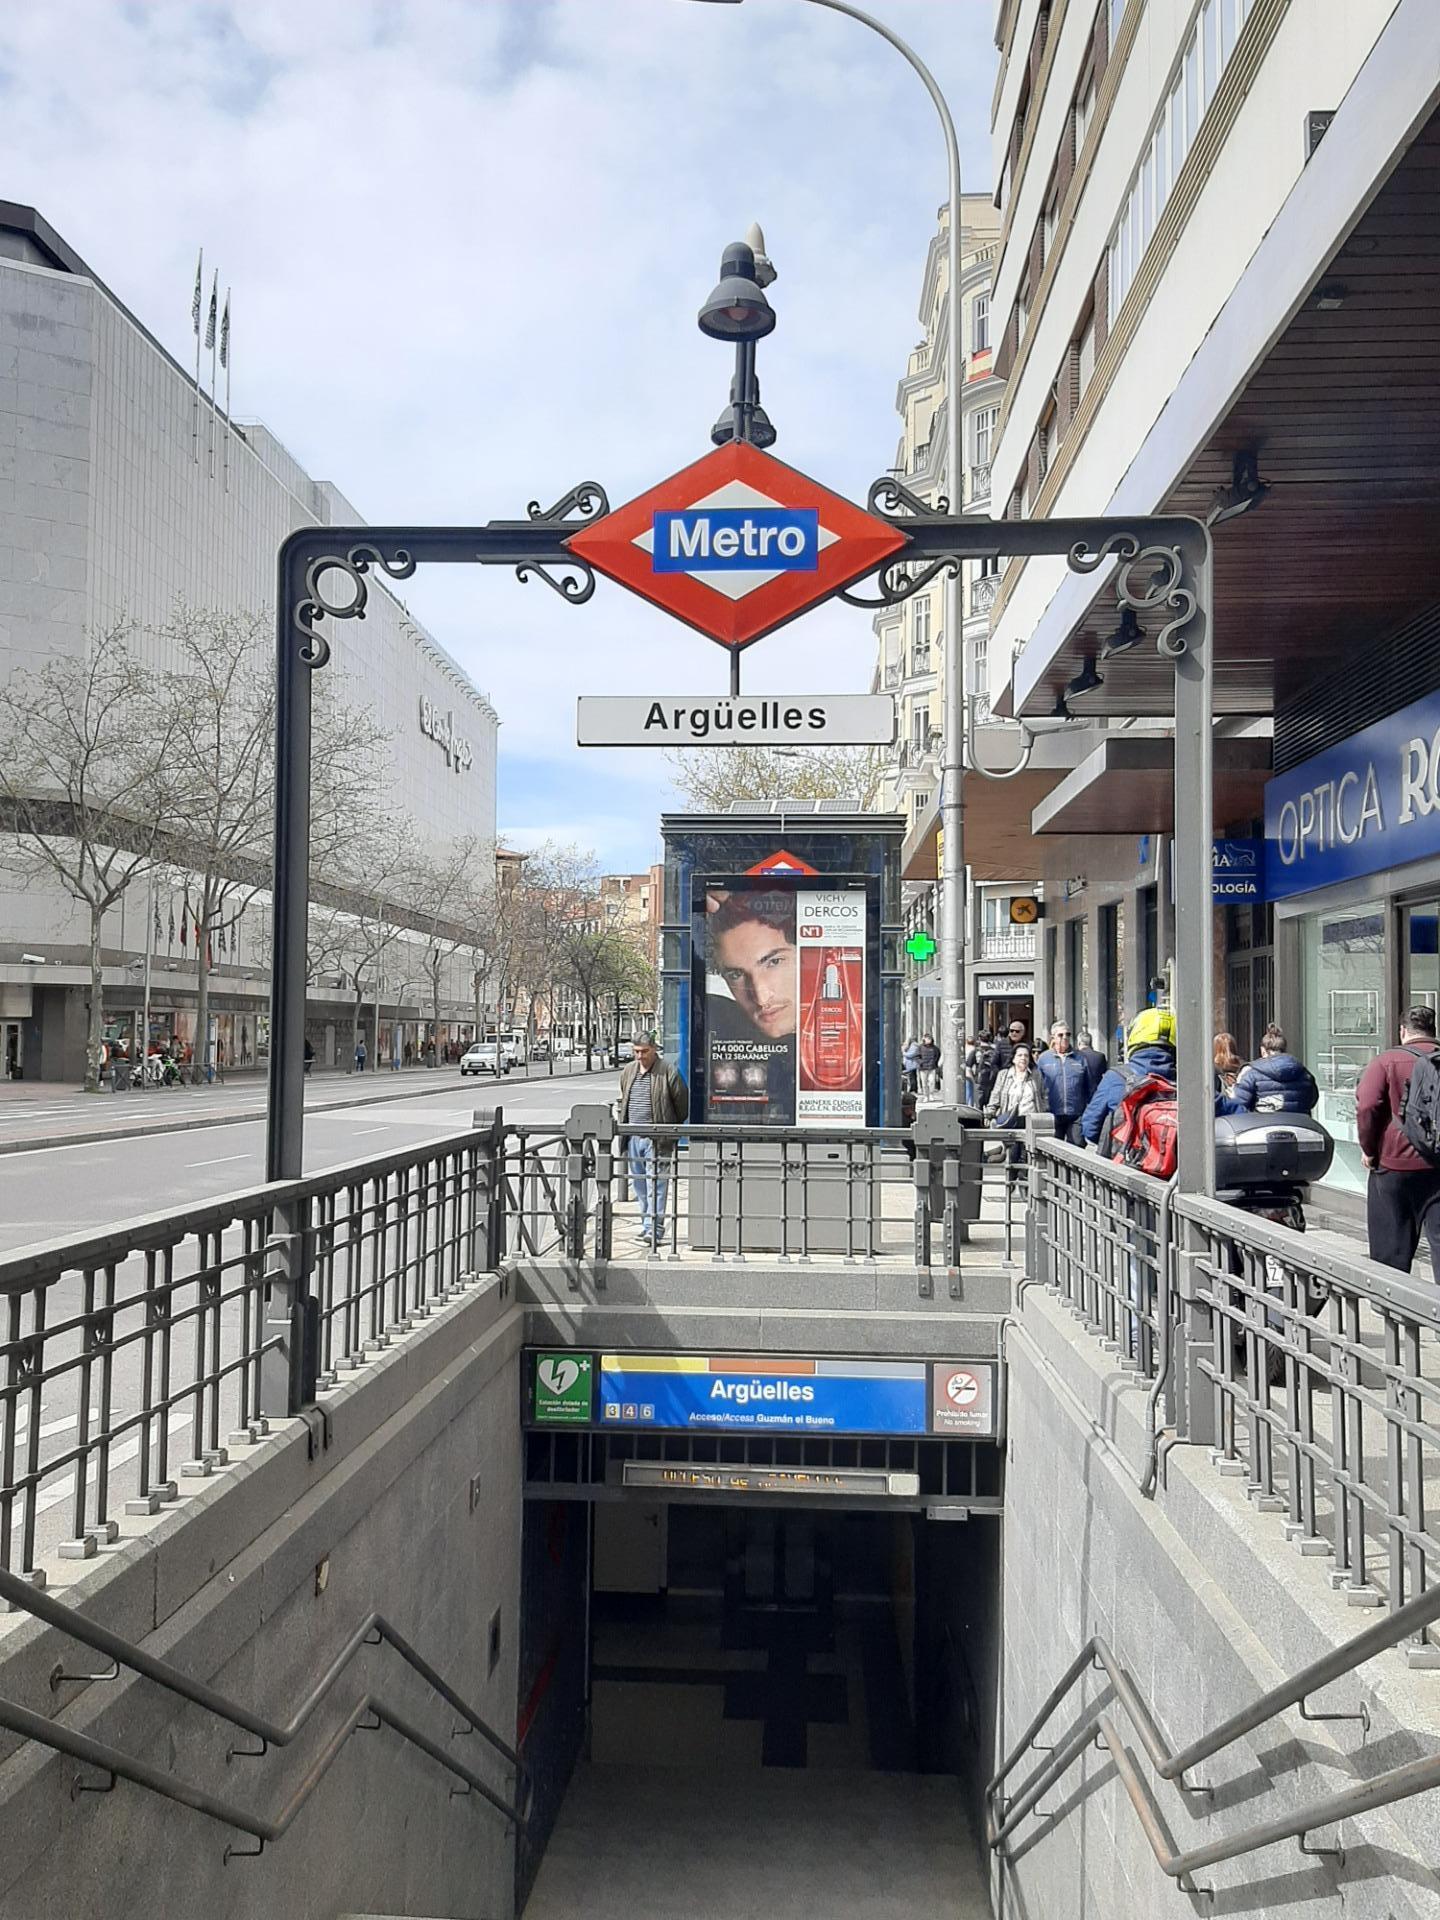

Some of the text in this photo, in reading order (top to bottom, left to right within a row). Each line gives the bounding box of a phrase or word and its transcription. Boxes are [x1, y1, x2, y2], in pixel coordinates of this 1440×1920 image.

[670, 519, 805, 557] Metro
[643, 702, 827, 737] Argüelles
[1278, 761, 1385, 866] OPTICA
[816, 895, 848, 903] VICHY
[804, 906, 858, 917] DERCOS
[986, 981, 1029, 991] DAN JOHN
[746, 1045, 788, 1053] CABELLOS
[710, 1379, 814, 1403] Argüelles
[608, 1406, 617, 1417] 3
[689, 1412, 835, 1425] Acceso/Access Guzmán el Bueno
